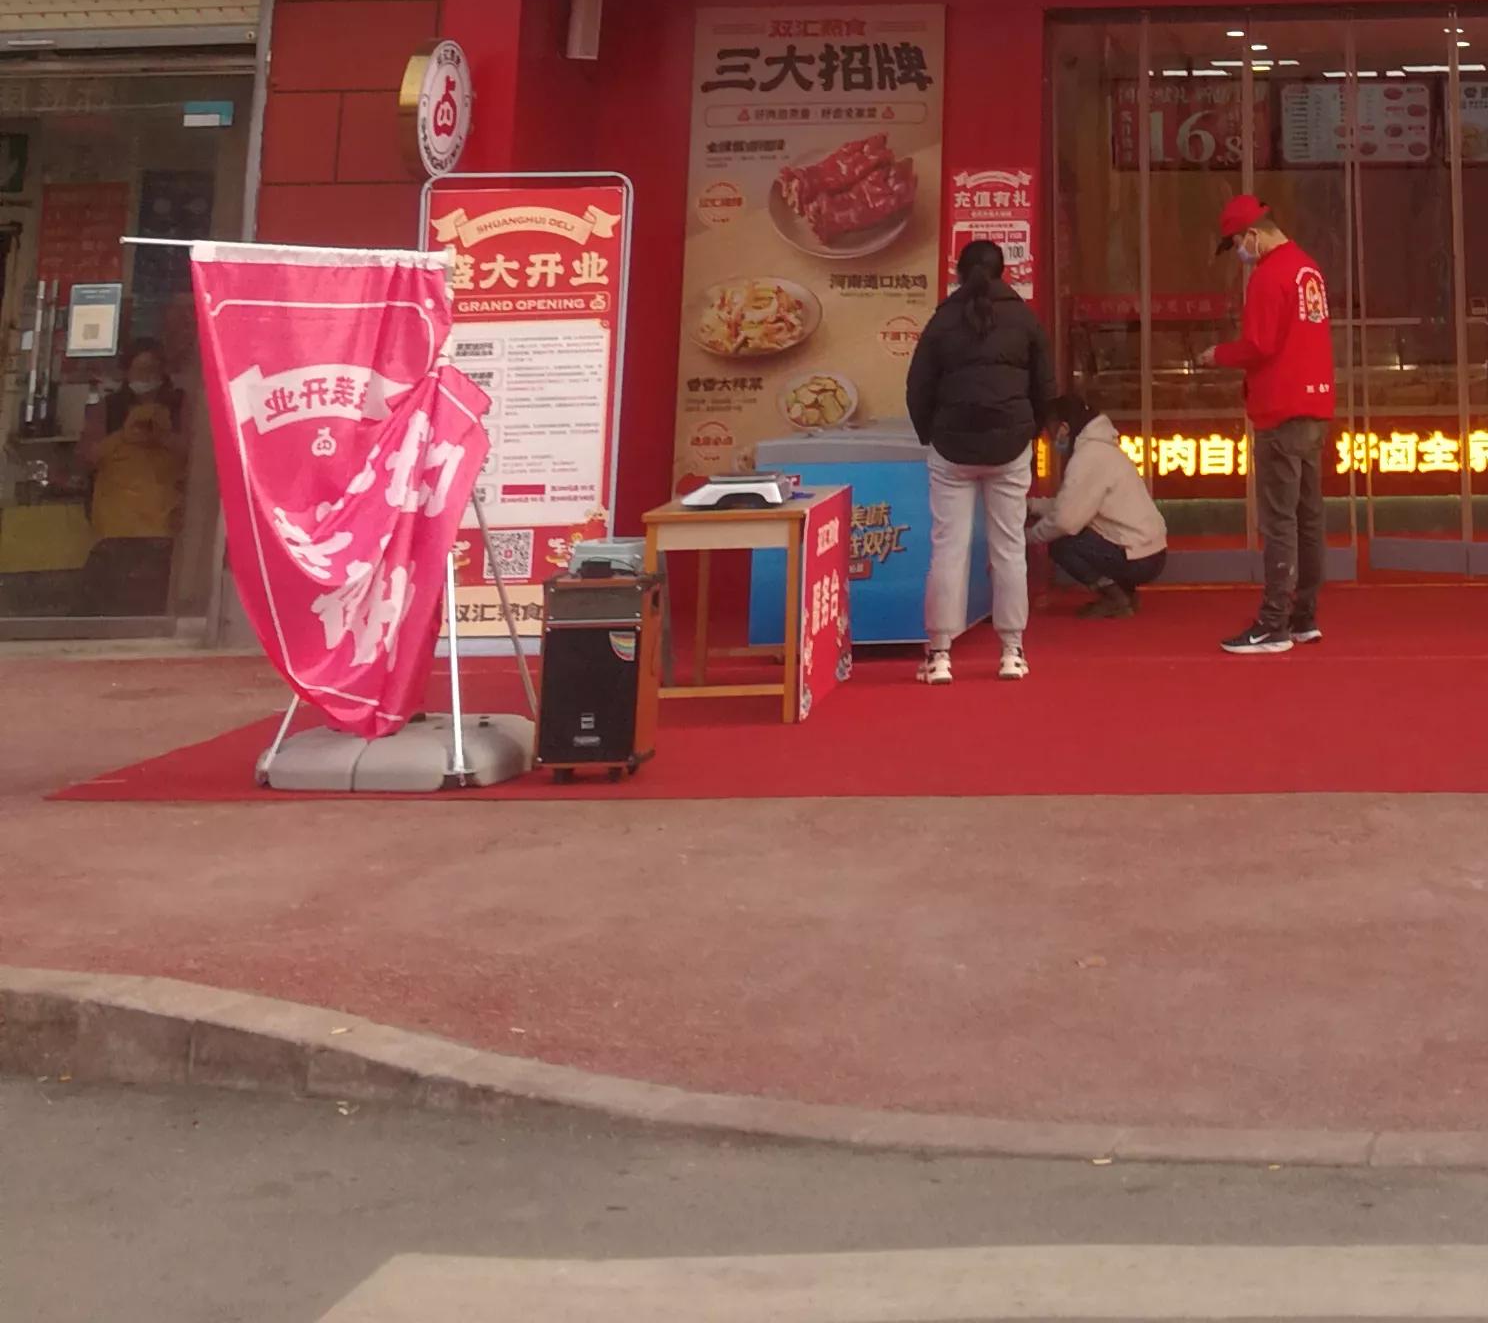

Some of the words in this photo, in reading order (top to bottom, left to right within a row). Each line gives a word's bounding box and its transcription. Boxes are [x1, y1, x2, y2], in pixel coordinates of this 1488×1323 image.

[700, 42, 933, 93] 三大招牌
[458, 299, 513, 313] GRAND
[515, 297, 585, 311] OPENING
